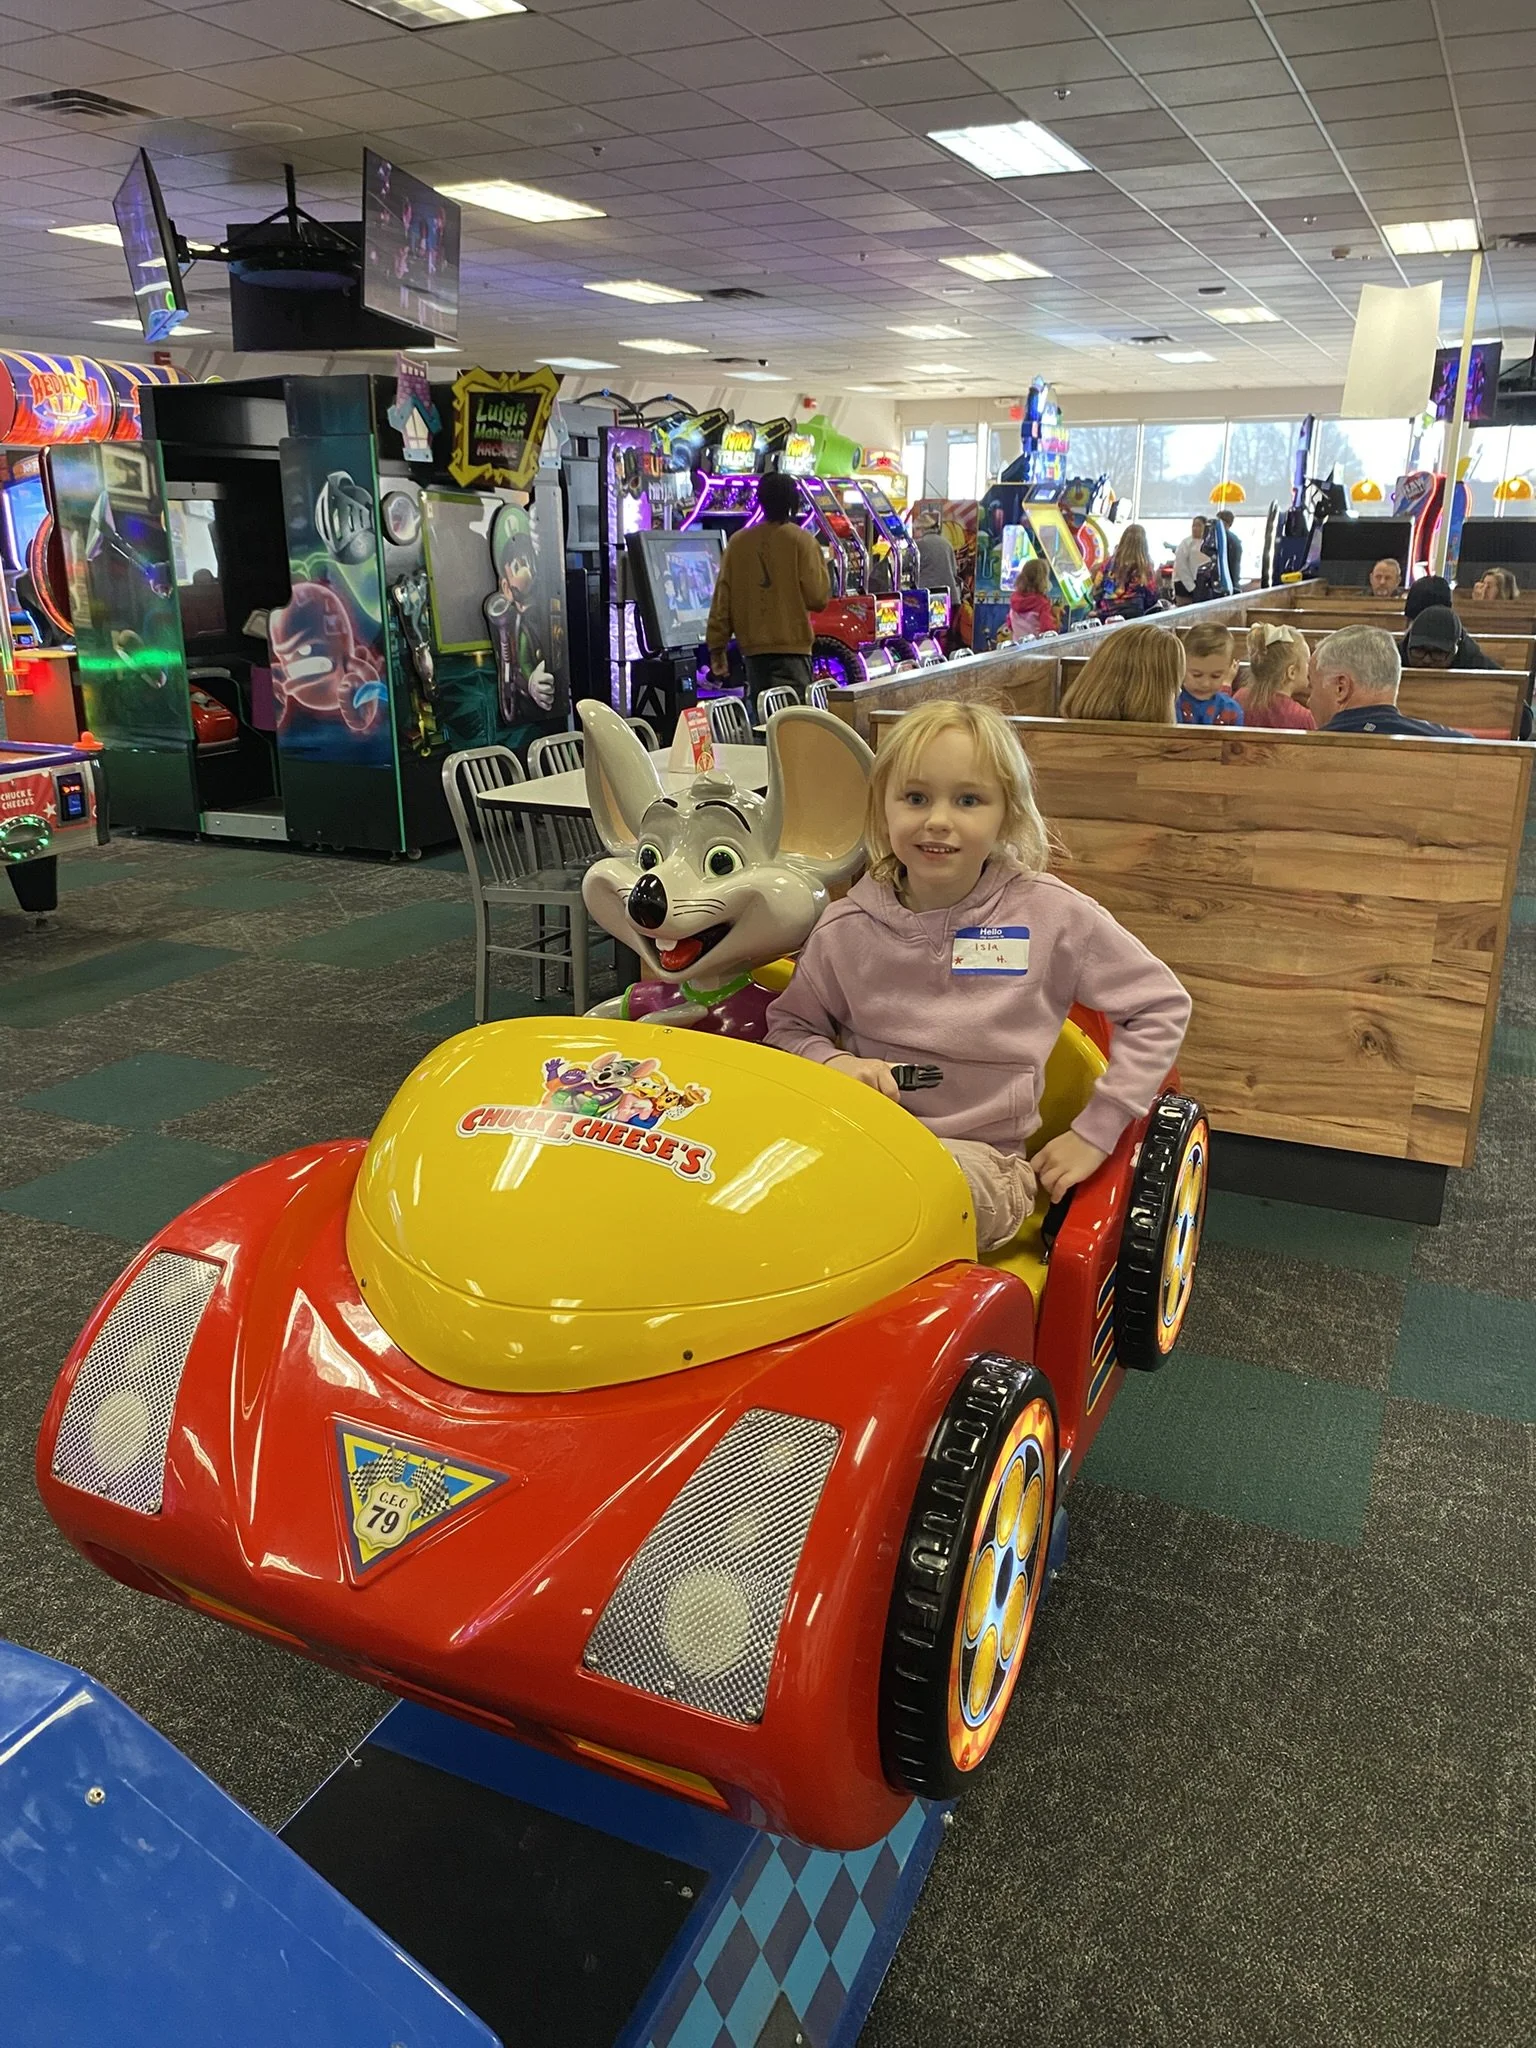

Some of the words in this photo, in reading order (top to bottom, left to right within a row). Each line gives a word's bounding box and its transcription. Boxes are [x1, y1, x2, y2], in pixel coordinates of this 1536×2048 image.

[476, 397, 528, 427] Luigi's
[476, 442, 518, 458] ARCADE
[0, 790, 26, 801] CHUCK
[2, 797, 35, 810] CHEESE'S
[980, 927, 1003, 936] Hello
[461, 1107, 554, 1132] CHUCK
[572, 1117, 705, 1175] CHEESE'S
[366, 1504, 401, 1534] 79
